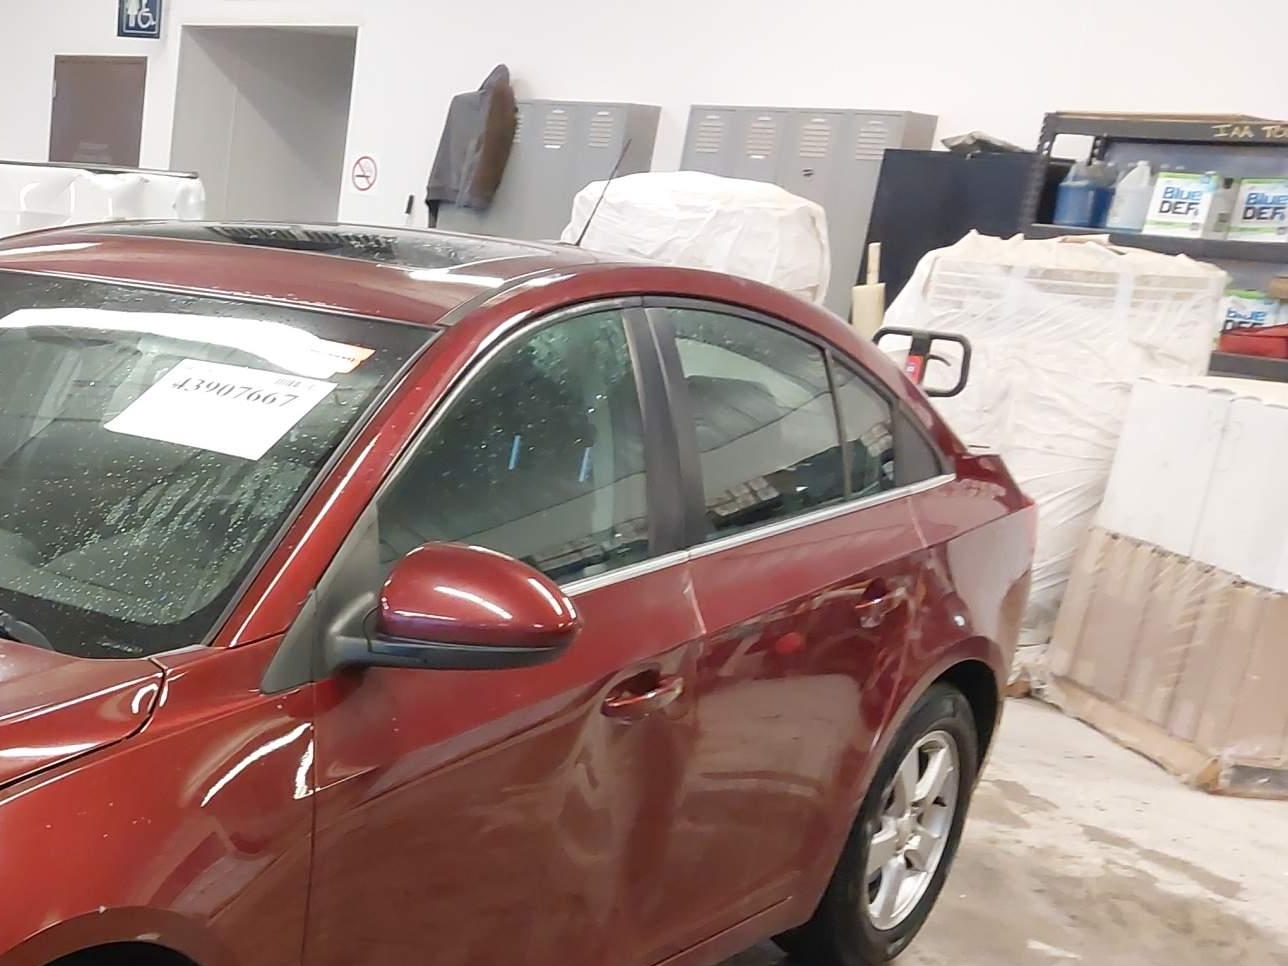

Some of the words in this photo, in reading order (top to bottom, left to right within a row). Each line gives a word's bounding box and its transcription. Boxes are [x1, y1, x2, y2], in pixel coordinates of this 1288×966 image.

[1211, 124, 1255, 138] IAA
[1159, 200, 1200, 215] DEF
[1242, 206, 1286, 220] DEF
[172, 377, 300, 407] 43907667
